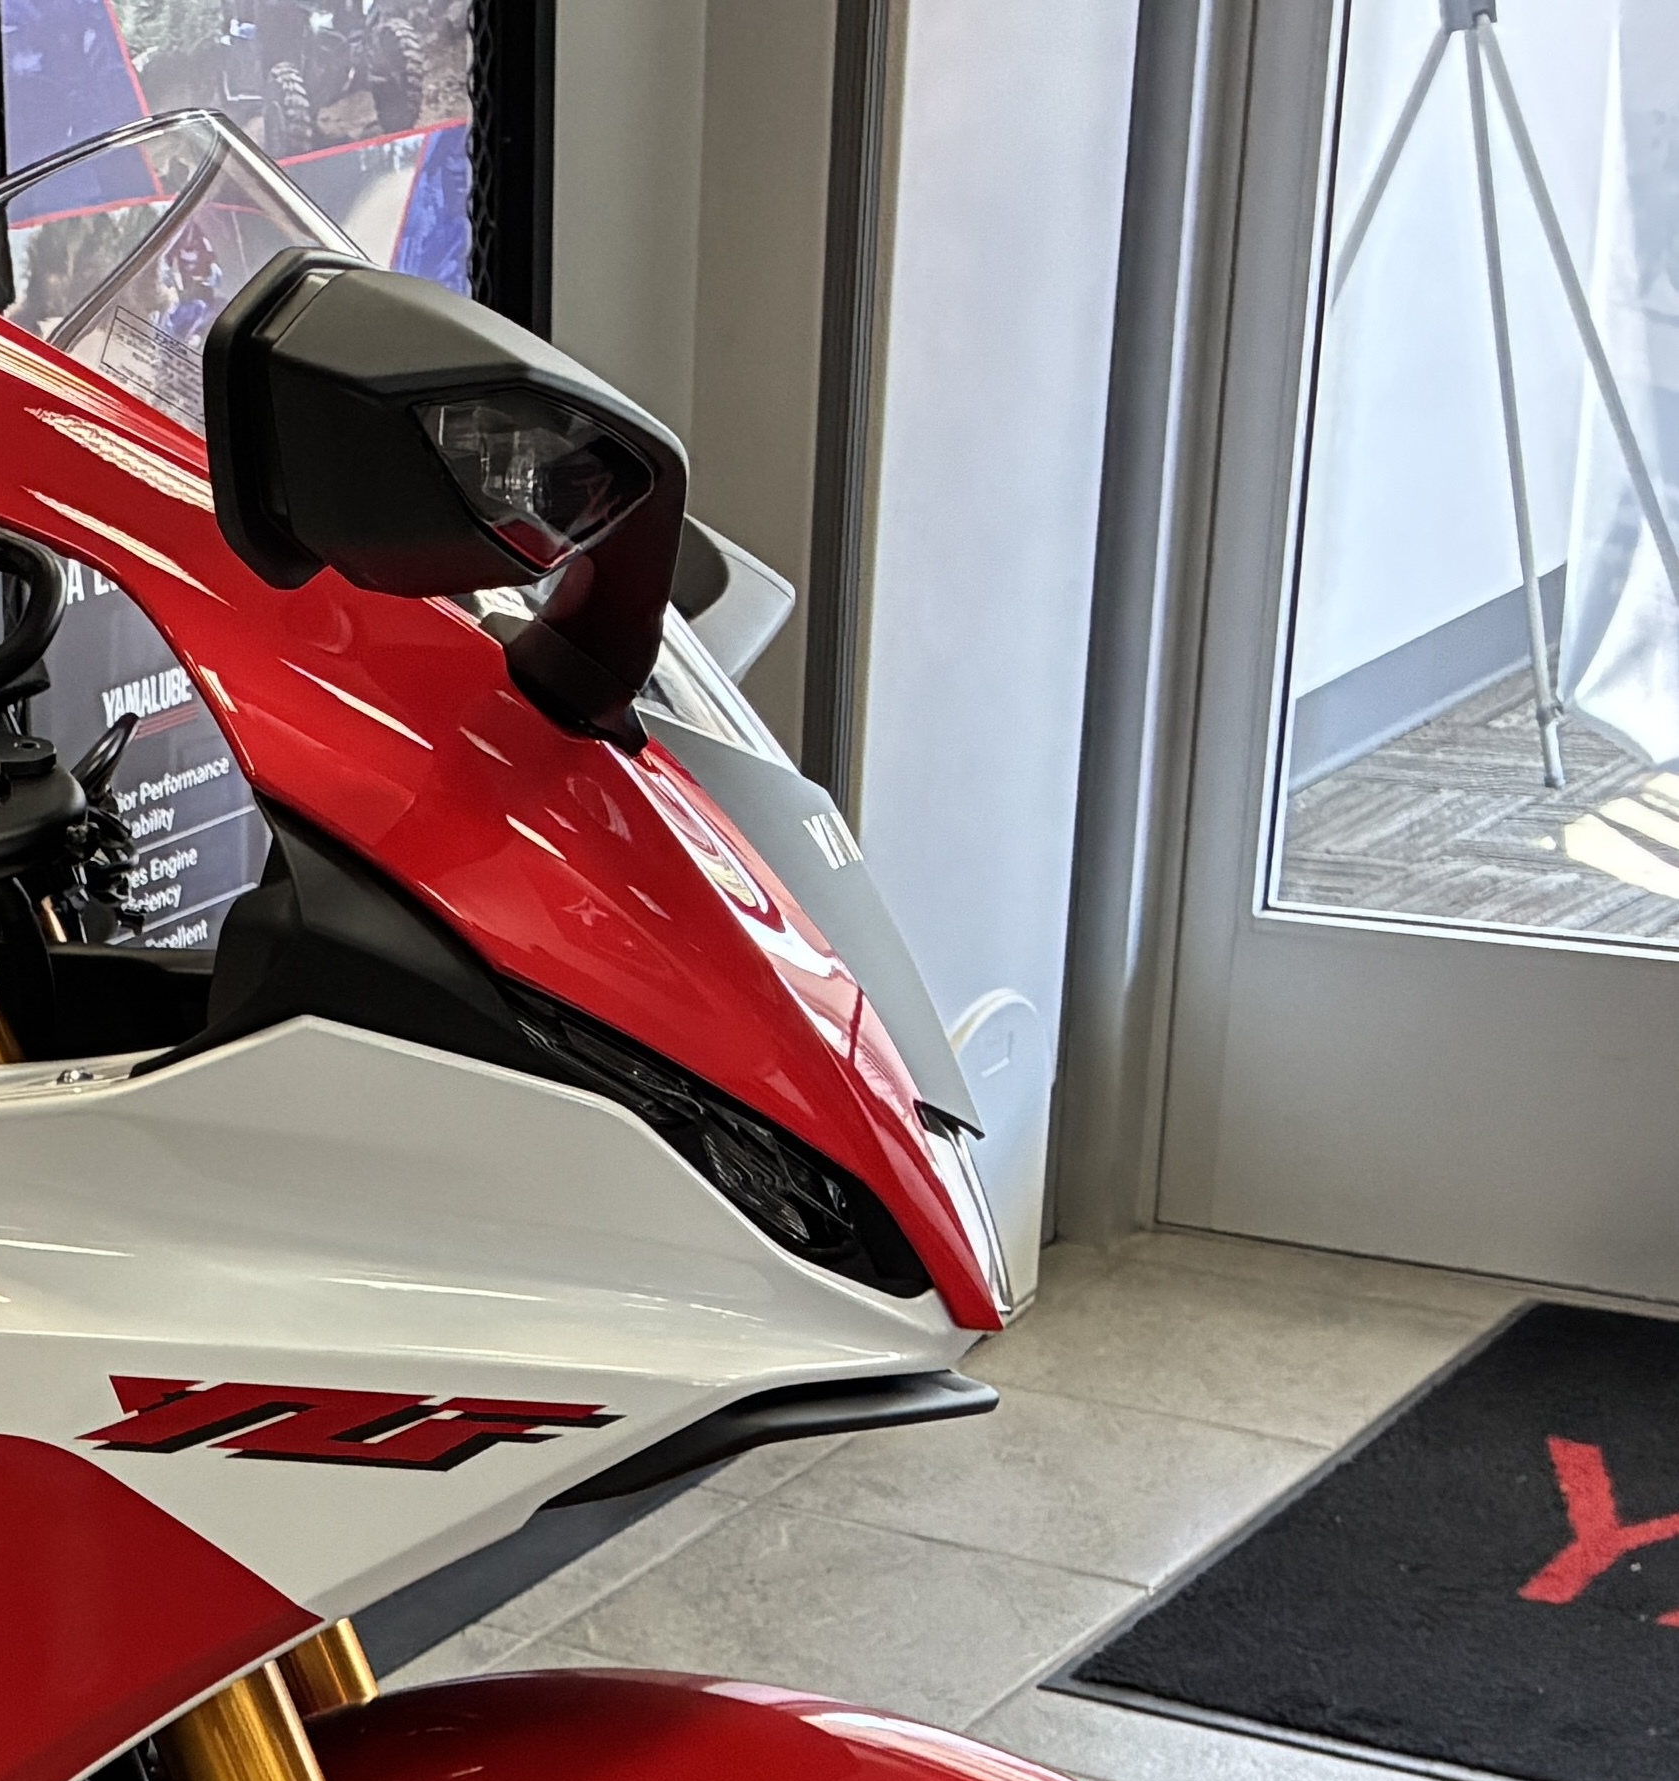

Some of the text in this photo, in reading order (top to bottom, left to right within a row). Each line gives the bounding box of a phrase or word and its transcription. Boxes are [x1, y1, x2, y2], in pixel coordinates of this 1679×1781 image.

[102, 666, 193, 729] YAMALUBE
[116, 756, 230, 814] ior Performance
[124, 807, 176, 840] ability
[150, 847, 199, 882] Engine
